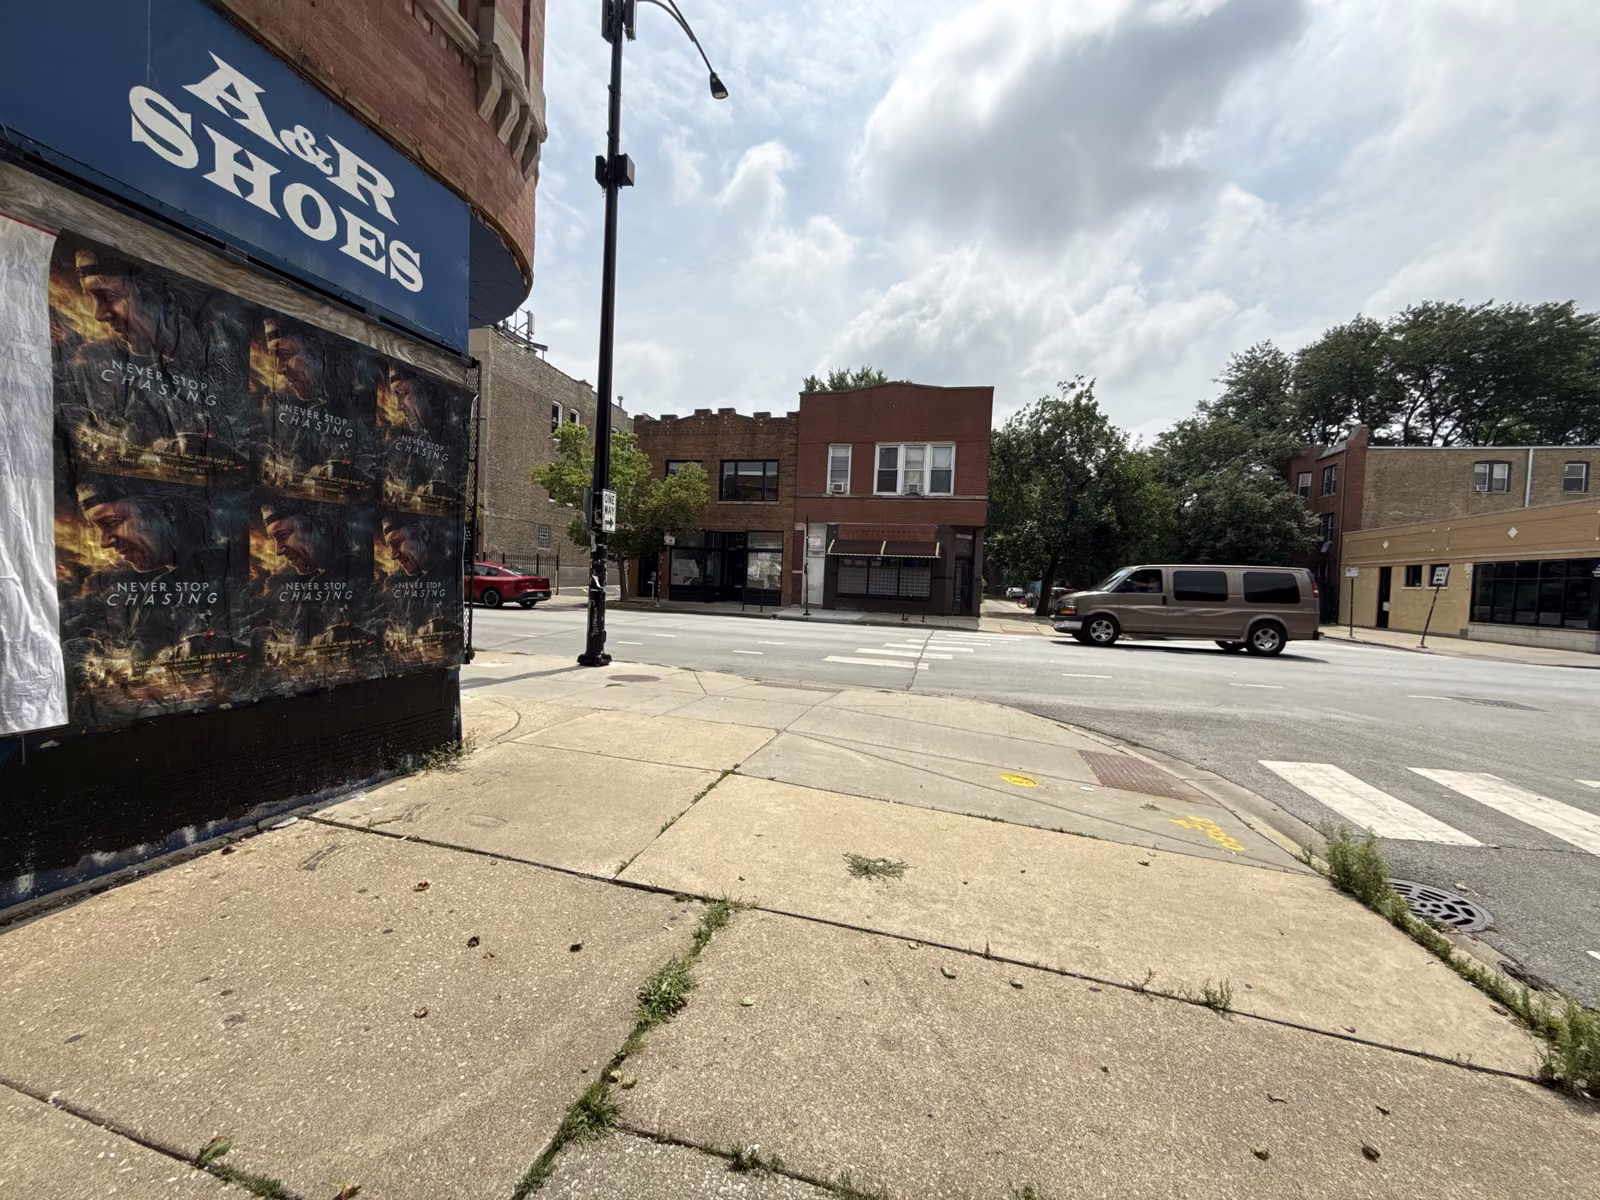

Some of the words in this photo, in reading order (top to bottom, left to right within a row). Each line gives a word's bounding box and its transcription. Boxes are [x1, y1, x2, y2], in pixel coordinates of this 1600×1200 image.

[182, 50, 400, 225] A&R
[128, 85, 424, 293] SHOES
[112, 359, 163, 382] NEVER
[172, 374, 208, 391] STOP
[101, 369, 217, 406] CHASING
[285, 404, 319, 420] NEVER
[324, 414, 347, 426] STOP
[278, 412, 353, 438] CHASING
[401, 435, 425, 447] NEVER
[427, 441, 444, 451] STOP
[395, 442, 449, 461] CHASING
[604, 493, 615, 505] ONE
[604, 505, 615, 516] WAY
[117, 582, 167, 593] NEVER
[175, 582, 210, 591] STOP
[285, 582, 319, 591] NEVER
[324, 582, 347, 590] STOP
[398, 581, 423, 589] NEVER
[426, 581, 442, 589] STOP
[107, 592, 218, 607] CHASING
[279, 590, 353, 602] CHASING
[393, 589, 446, 598] CHASING
